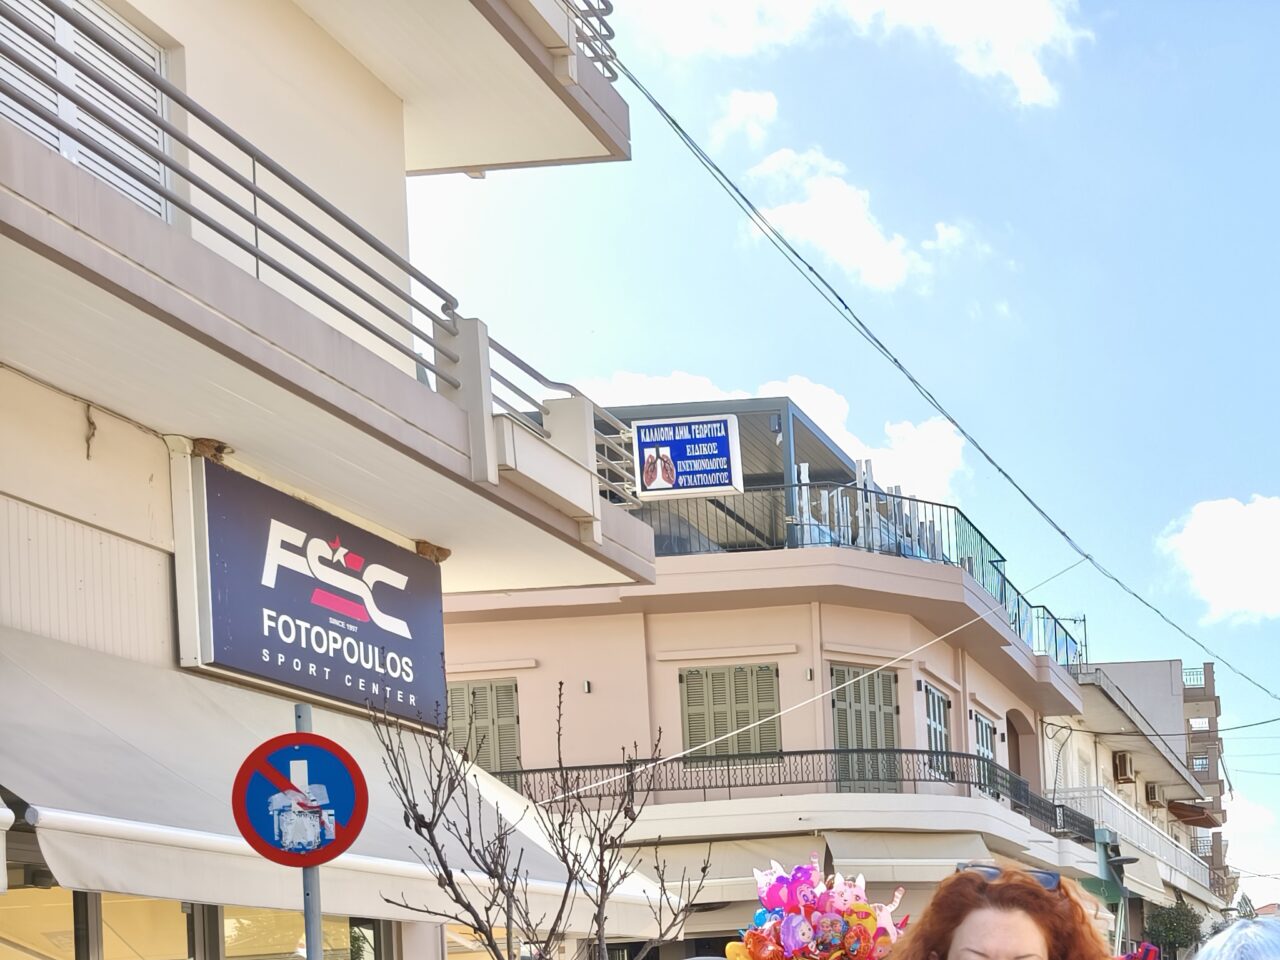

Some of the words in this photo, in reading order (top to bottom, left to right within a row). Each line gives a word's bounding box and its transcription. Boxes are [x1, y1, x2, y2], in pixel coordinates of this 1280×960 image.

[677, 458, 727, 472] ΠΝΕΥΜΟΝΟΛΟΓΟΣ
[686, 443, 718, 456] ΕΙΔΙΚΟΣ
[678, 472, 729, 486] ΦΥΜΑΤΙΟΛΟΓΟΣ
[261, 518, 413, 640] FSC
[262, 607, 414, 683] FOTOPOULOS
[262, 649, 331, 680] SPORT
[344, 674, 417, 706] CENTER
